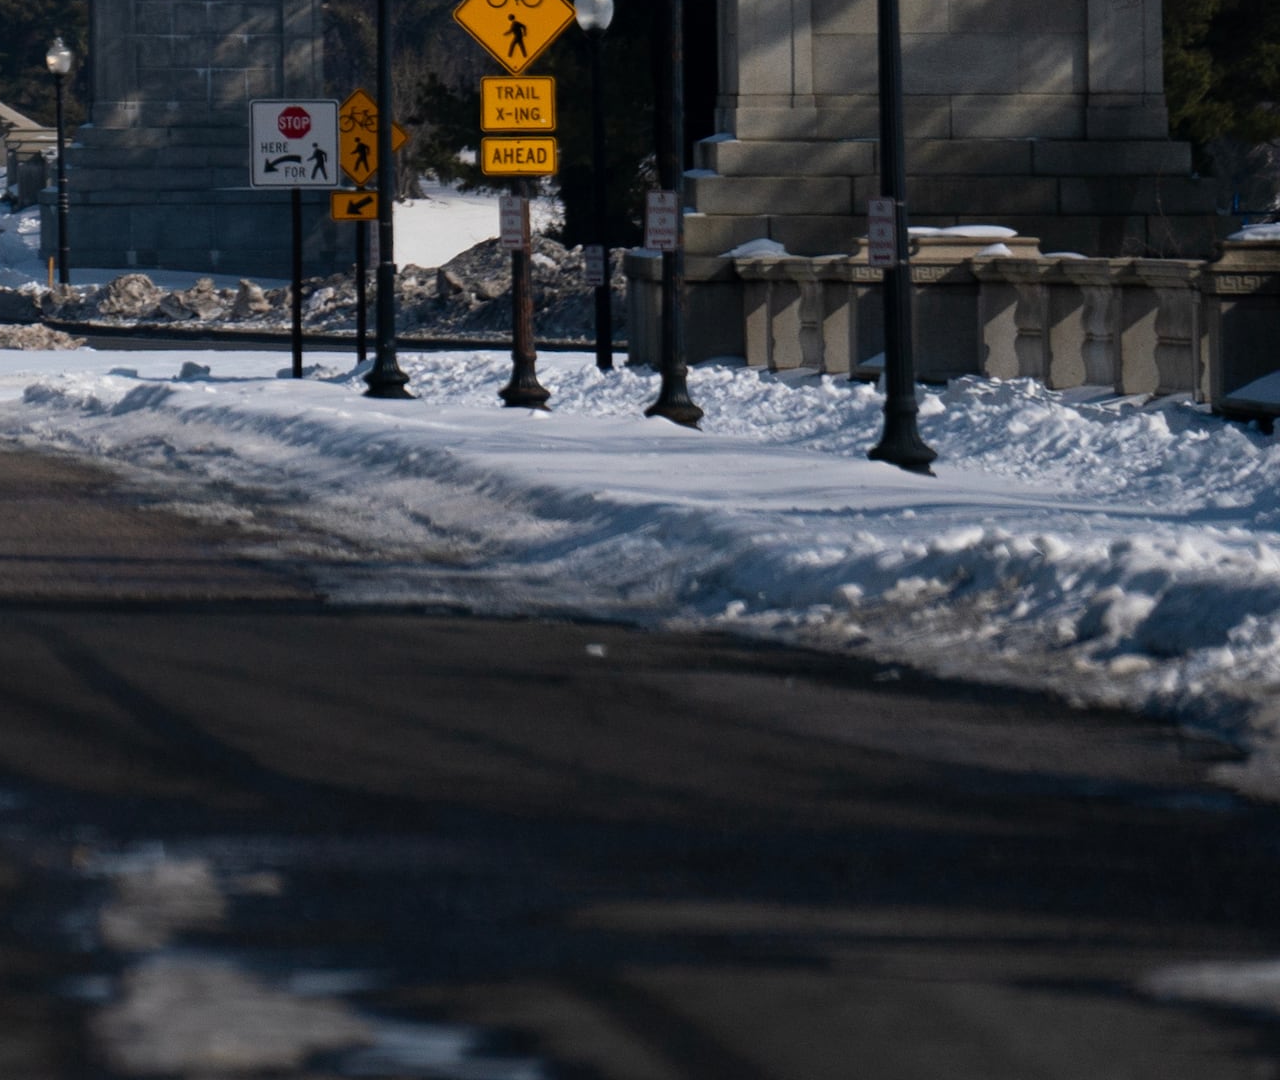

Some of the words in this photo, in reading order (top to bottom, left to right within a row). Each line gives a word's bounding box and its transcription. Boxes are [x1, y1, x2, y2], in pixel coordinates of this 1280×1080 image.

[496, 86, 540, 100] TRAIL
[496, 107, 540, 121] X-ING
[278, 116, 310, 130] STOP
[260, 141, 289, 153] HERE
[492, 147, 547, 164] AHEAD
[284, 166, 306, 178] FOR
